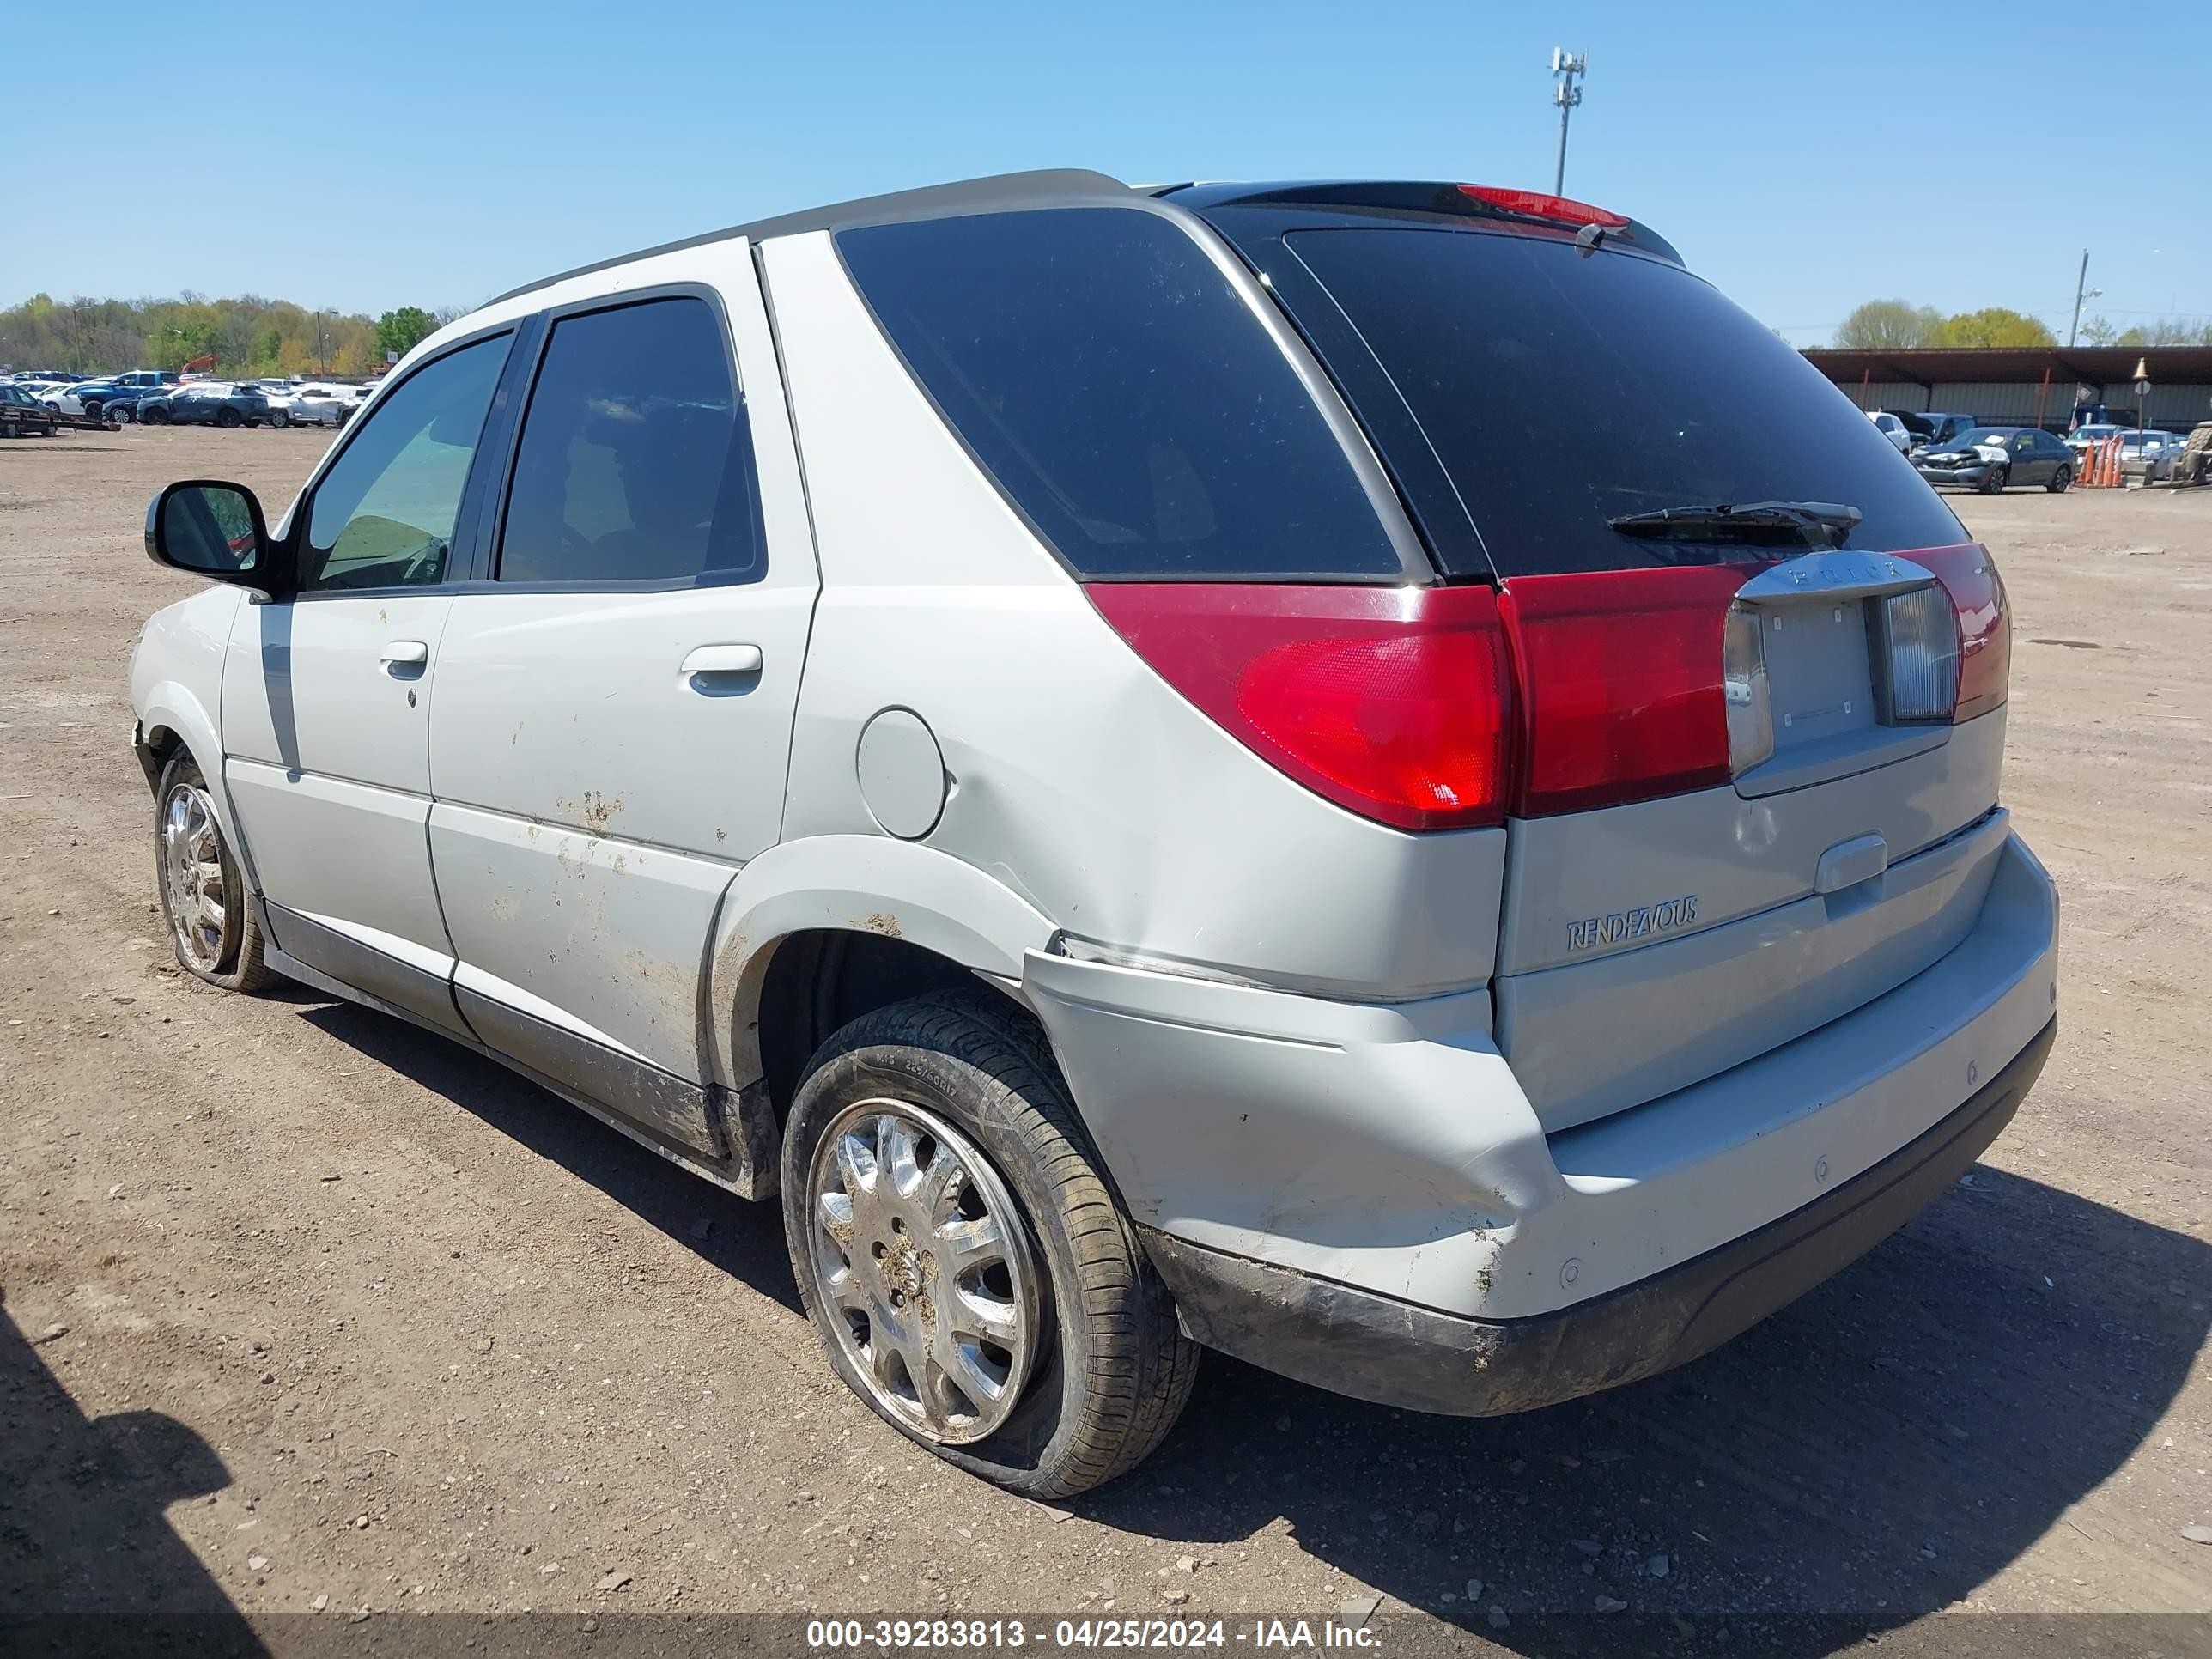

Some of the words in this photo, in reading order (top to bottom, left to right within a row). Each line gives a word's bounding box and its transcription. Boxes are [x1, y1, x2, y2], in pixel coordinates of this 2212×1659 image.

[1787, 561, 1903, 586] BUICK
[1567, 895, 1698, 951] RENDEZVOUS
[905, 1060, 957, 1097] 225/60R17
